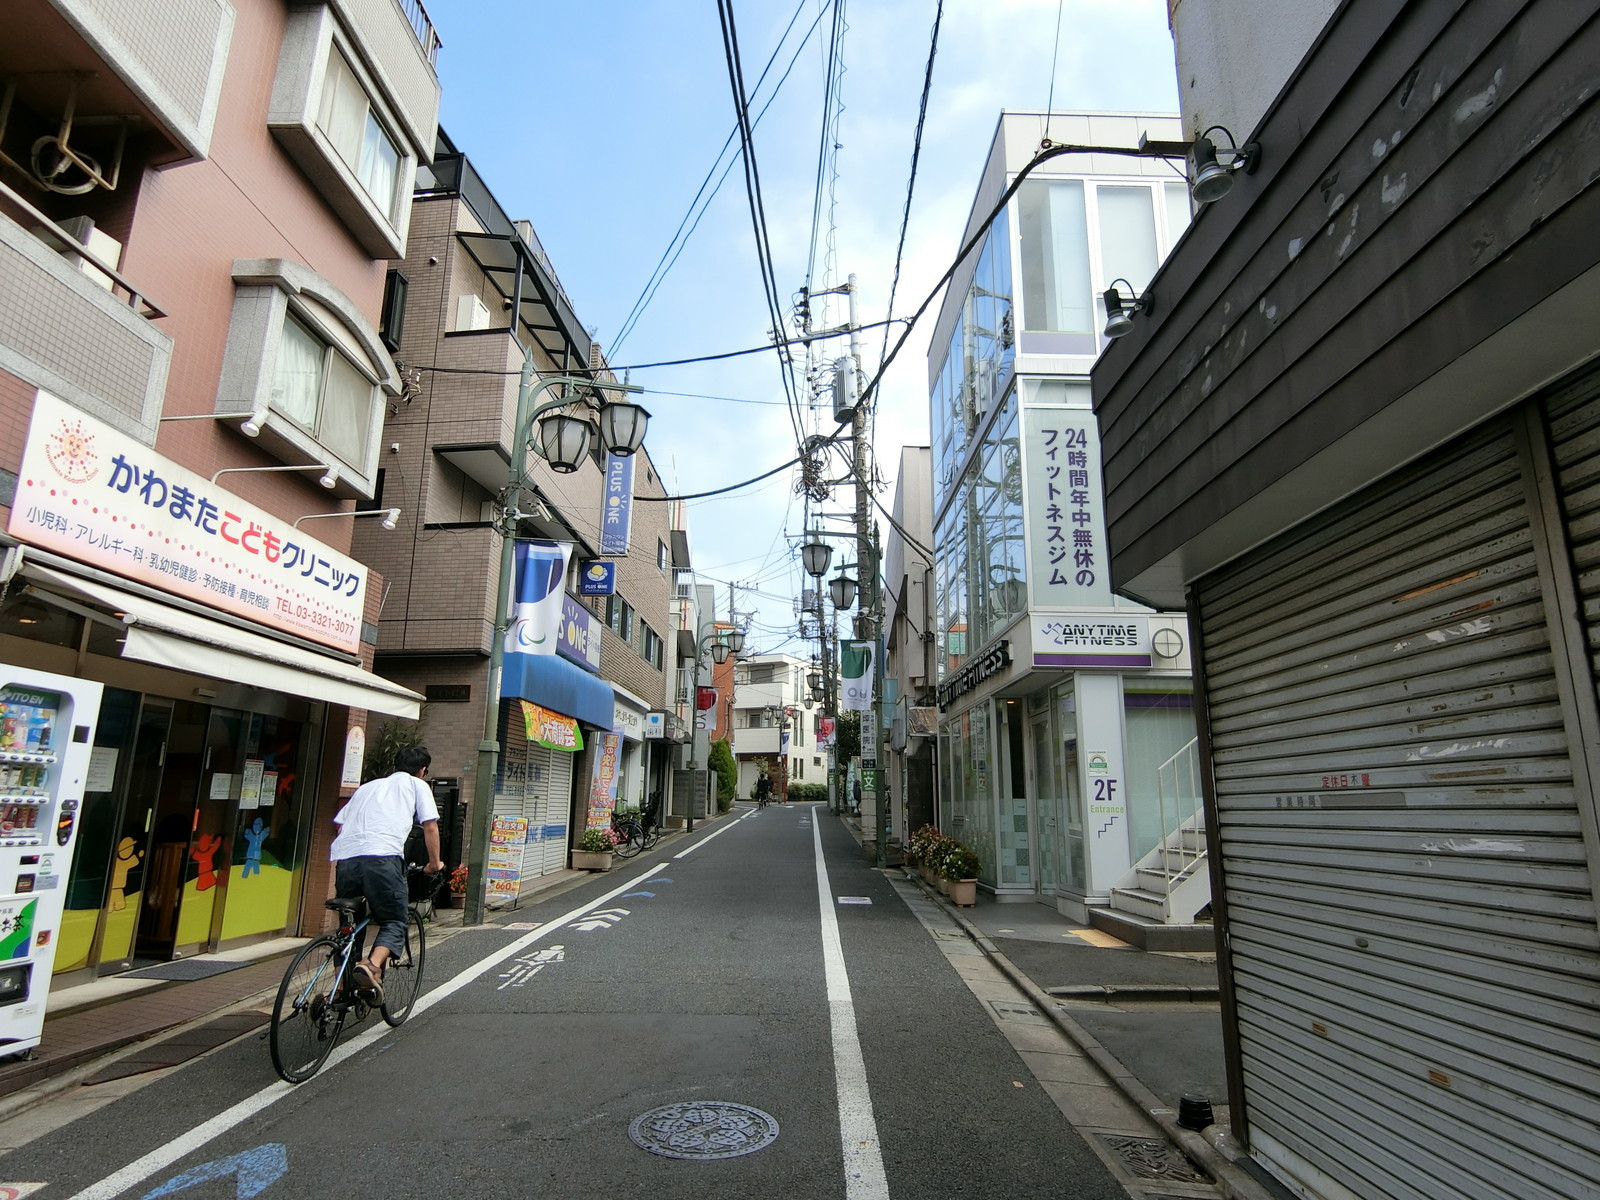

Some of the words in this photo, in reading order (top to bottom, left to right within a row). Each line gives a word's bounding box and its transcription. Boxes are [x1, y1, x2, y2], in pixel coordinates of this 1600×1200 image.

[609, 461, 624, 492] PLUS
[1041, 429, 1068, 586] フィットネスジム
[1065, 428, 1095, 587] 24時間年中無休の
[107, 454, 360, 597] かわまたこどもクリニック
[567, 620, 587, 655] ONE
[1062, 624, 1137, 636] ANYTIME
[1063, 636, 1138, 646] FITNESS
[11, 692, 30, 703] ITO
[29, 695, 44, 705] EN
[1094, 779, 1118, 801] 2F
[1090, 804, 1125, 814] Entrance
